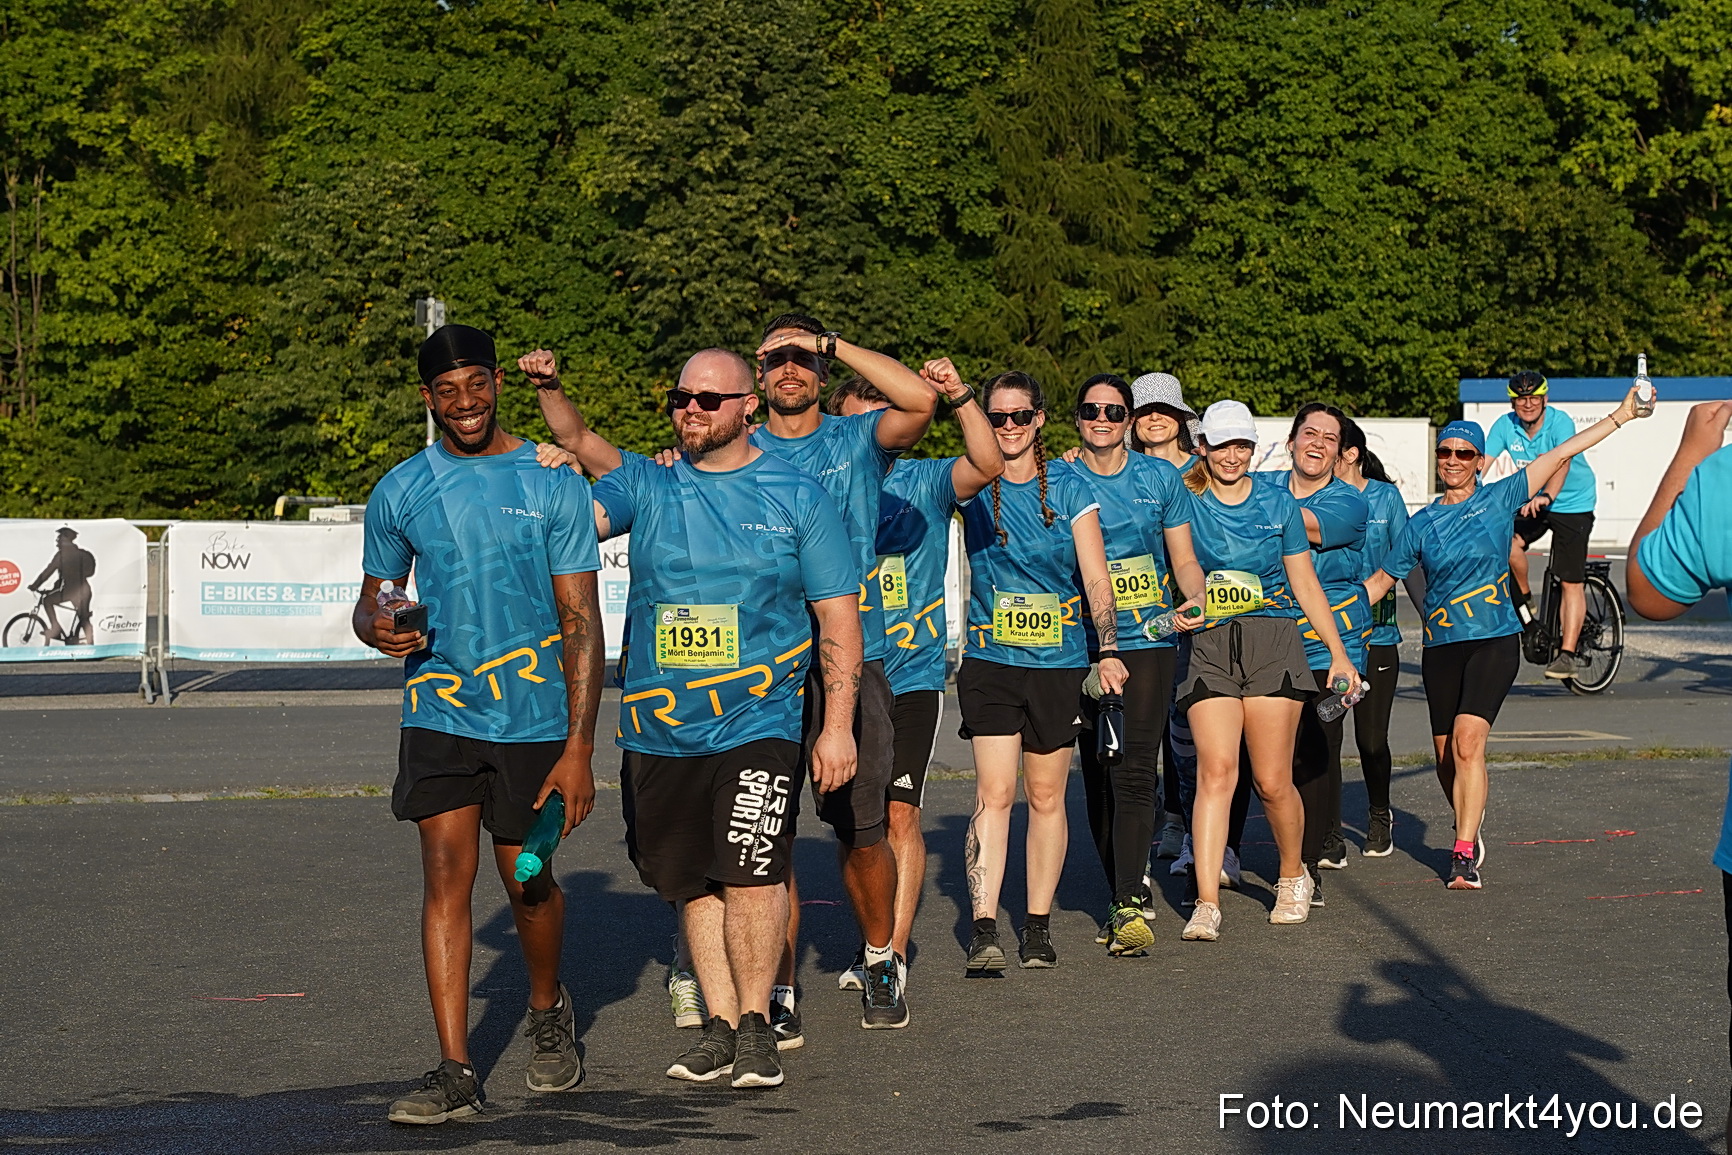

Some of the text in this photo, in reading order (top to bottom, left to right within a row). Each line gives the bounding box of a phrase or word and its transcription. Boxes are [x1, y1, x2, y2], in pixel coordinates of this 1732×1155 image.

[1447, 426, 1475, 437] PLAST
[827, 461, 850, 476] PLAST
[500, 506, 513, 515] TR
[1467, 507, 1487, 518] PLAST
[740, 523, 793, 534] TR PLAST
[205, 531, 247, 554] Bike
[201, 552, 251, 570] NOW
[204, 585, 278, 602] E-BIKES
[281, 585, 297, 602] &
[896, 575, 904, 601] 2022
[1150, 574, 1158, 598] 2022
[1207, 587, 1252, 604] 1900
[204, 604, 319, 616] DEIN NEUER BIKE-STORE
[107, 617, 142, 629] Fischer
[996, 612, 1004, 636] WALK
[1005, 610, 1052, 630] 1909
[668, 626, 721, 648] 1931
[1030, 630, 1046, 639] Anja
[726, 630, 734, 659] 2022
[667, 649, 725, 659] Mörtl Benjamin
[472, 647, 548, 702] TR
[894, 780, 914, 790] adidas
